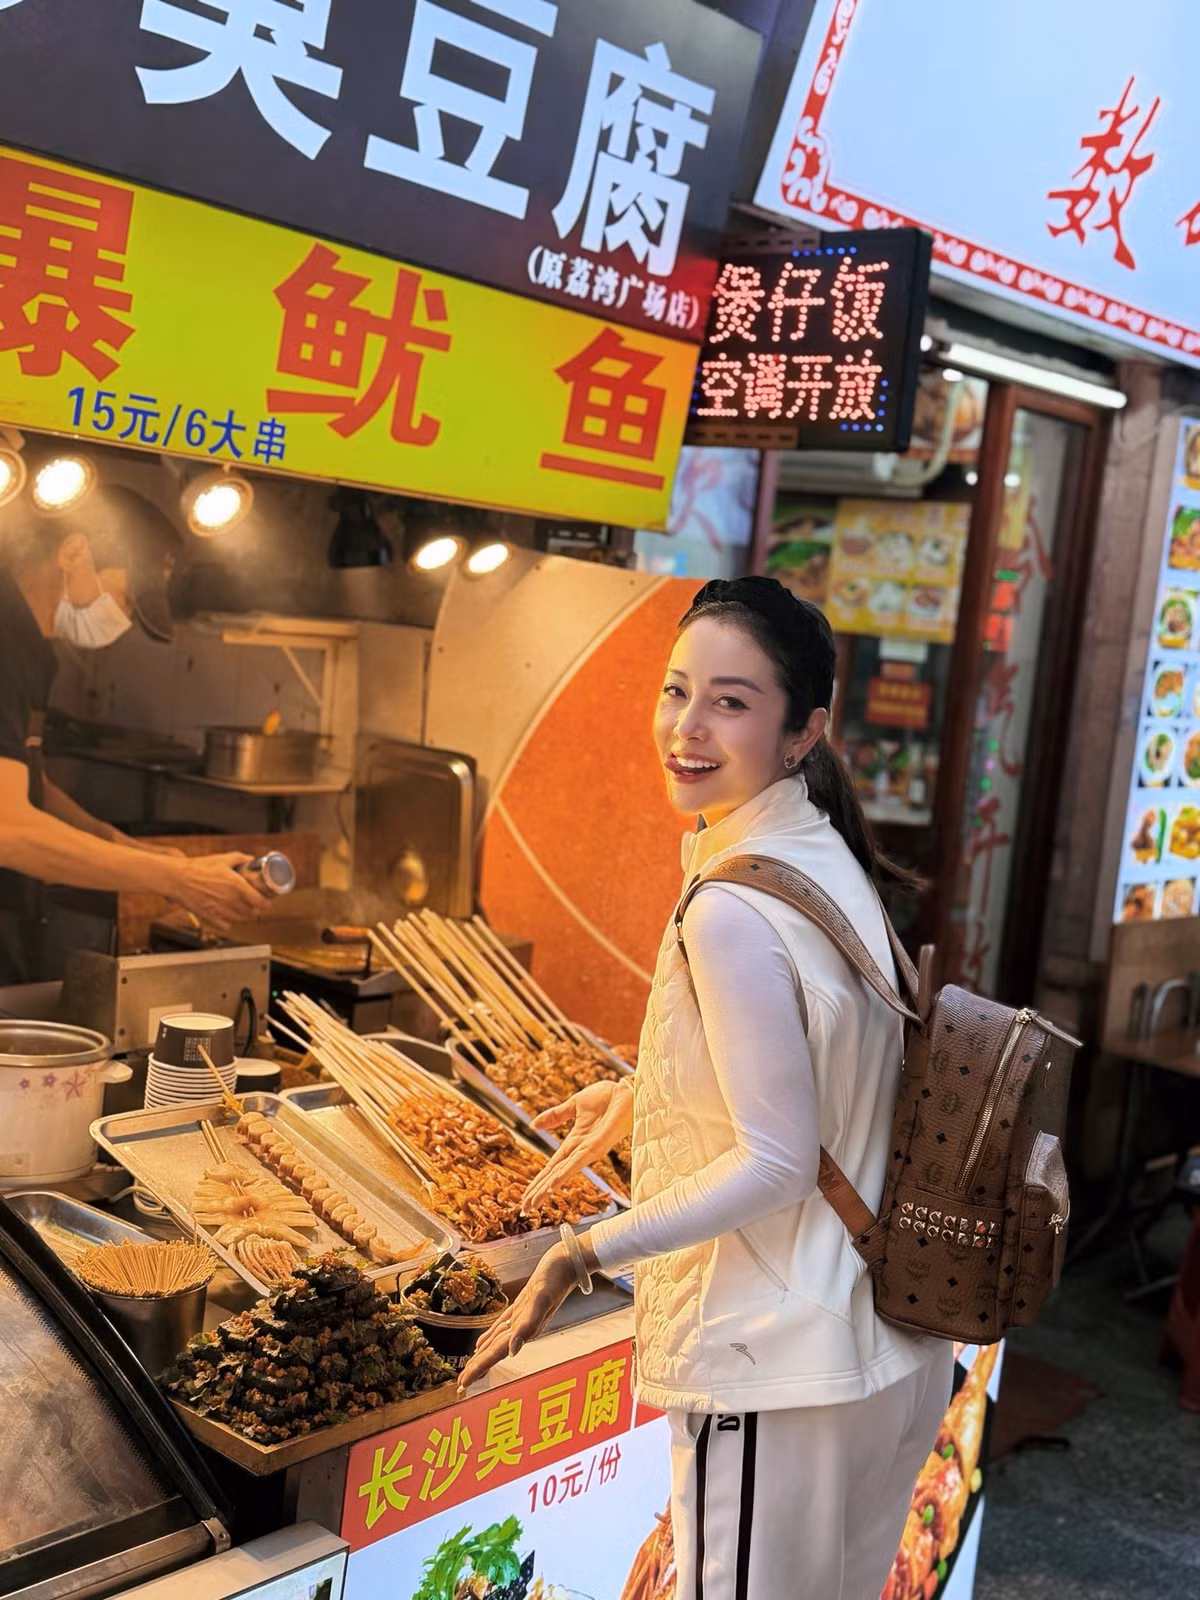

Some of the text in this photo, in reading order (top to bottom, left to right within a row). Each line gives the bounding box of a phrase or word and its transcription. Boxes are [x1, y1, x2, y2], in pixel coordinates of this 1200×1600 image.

[0, 0, 716, 277] 臭豆腐
[1046, 75, 1200, 270] 数
[67, 386, 287, 464] 15元/6大串
[358, 1356, 626, 1530] 长沙臭豆腐
[528, 1443, 621, 1513] 10元/份
